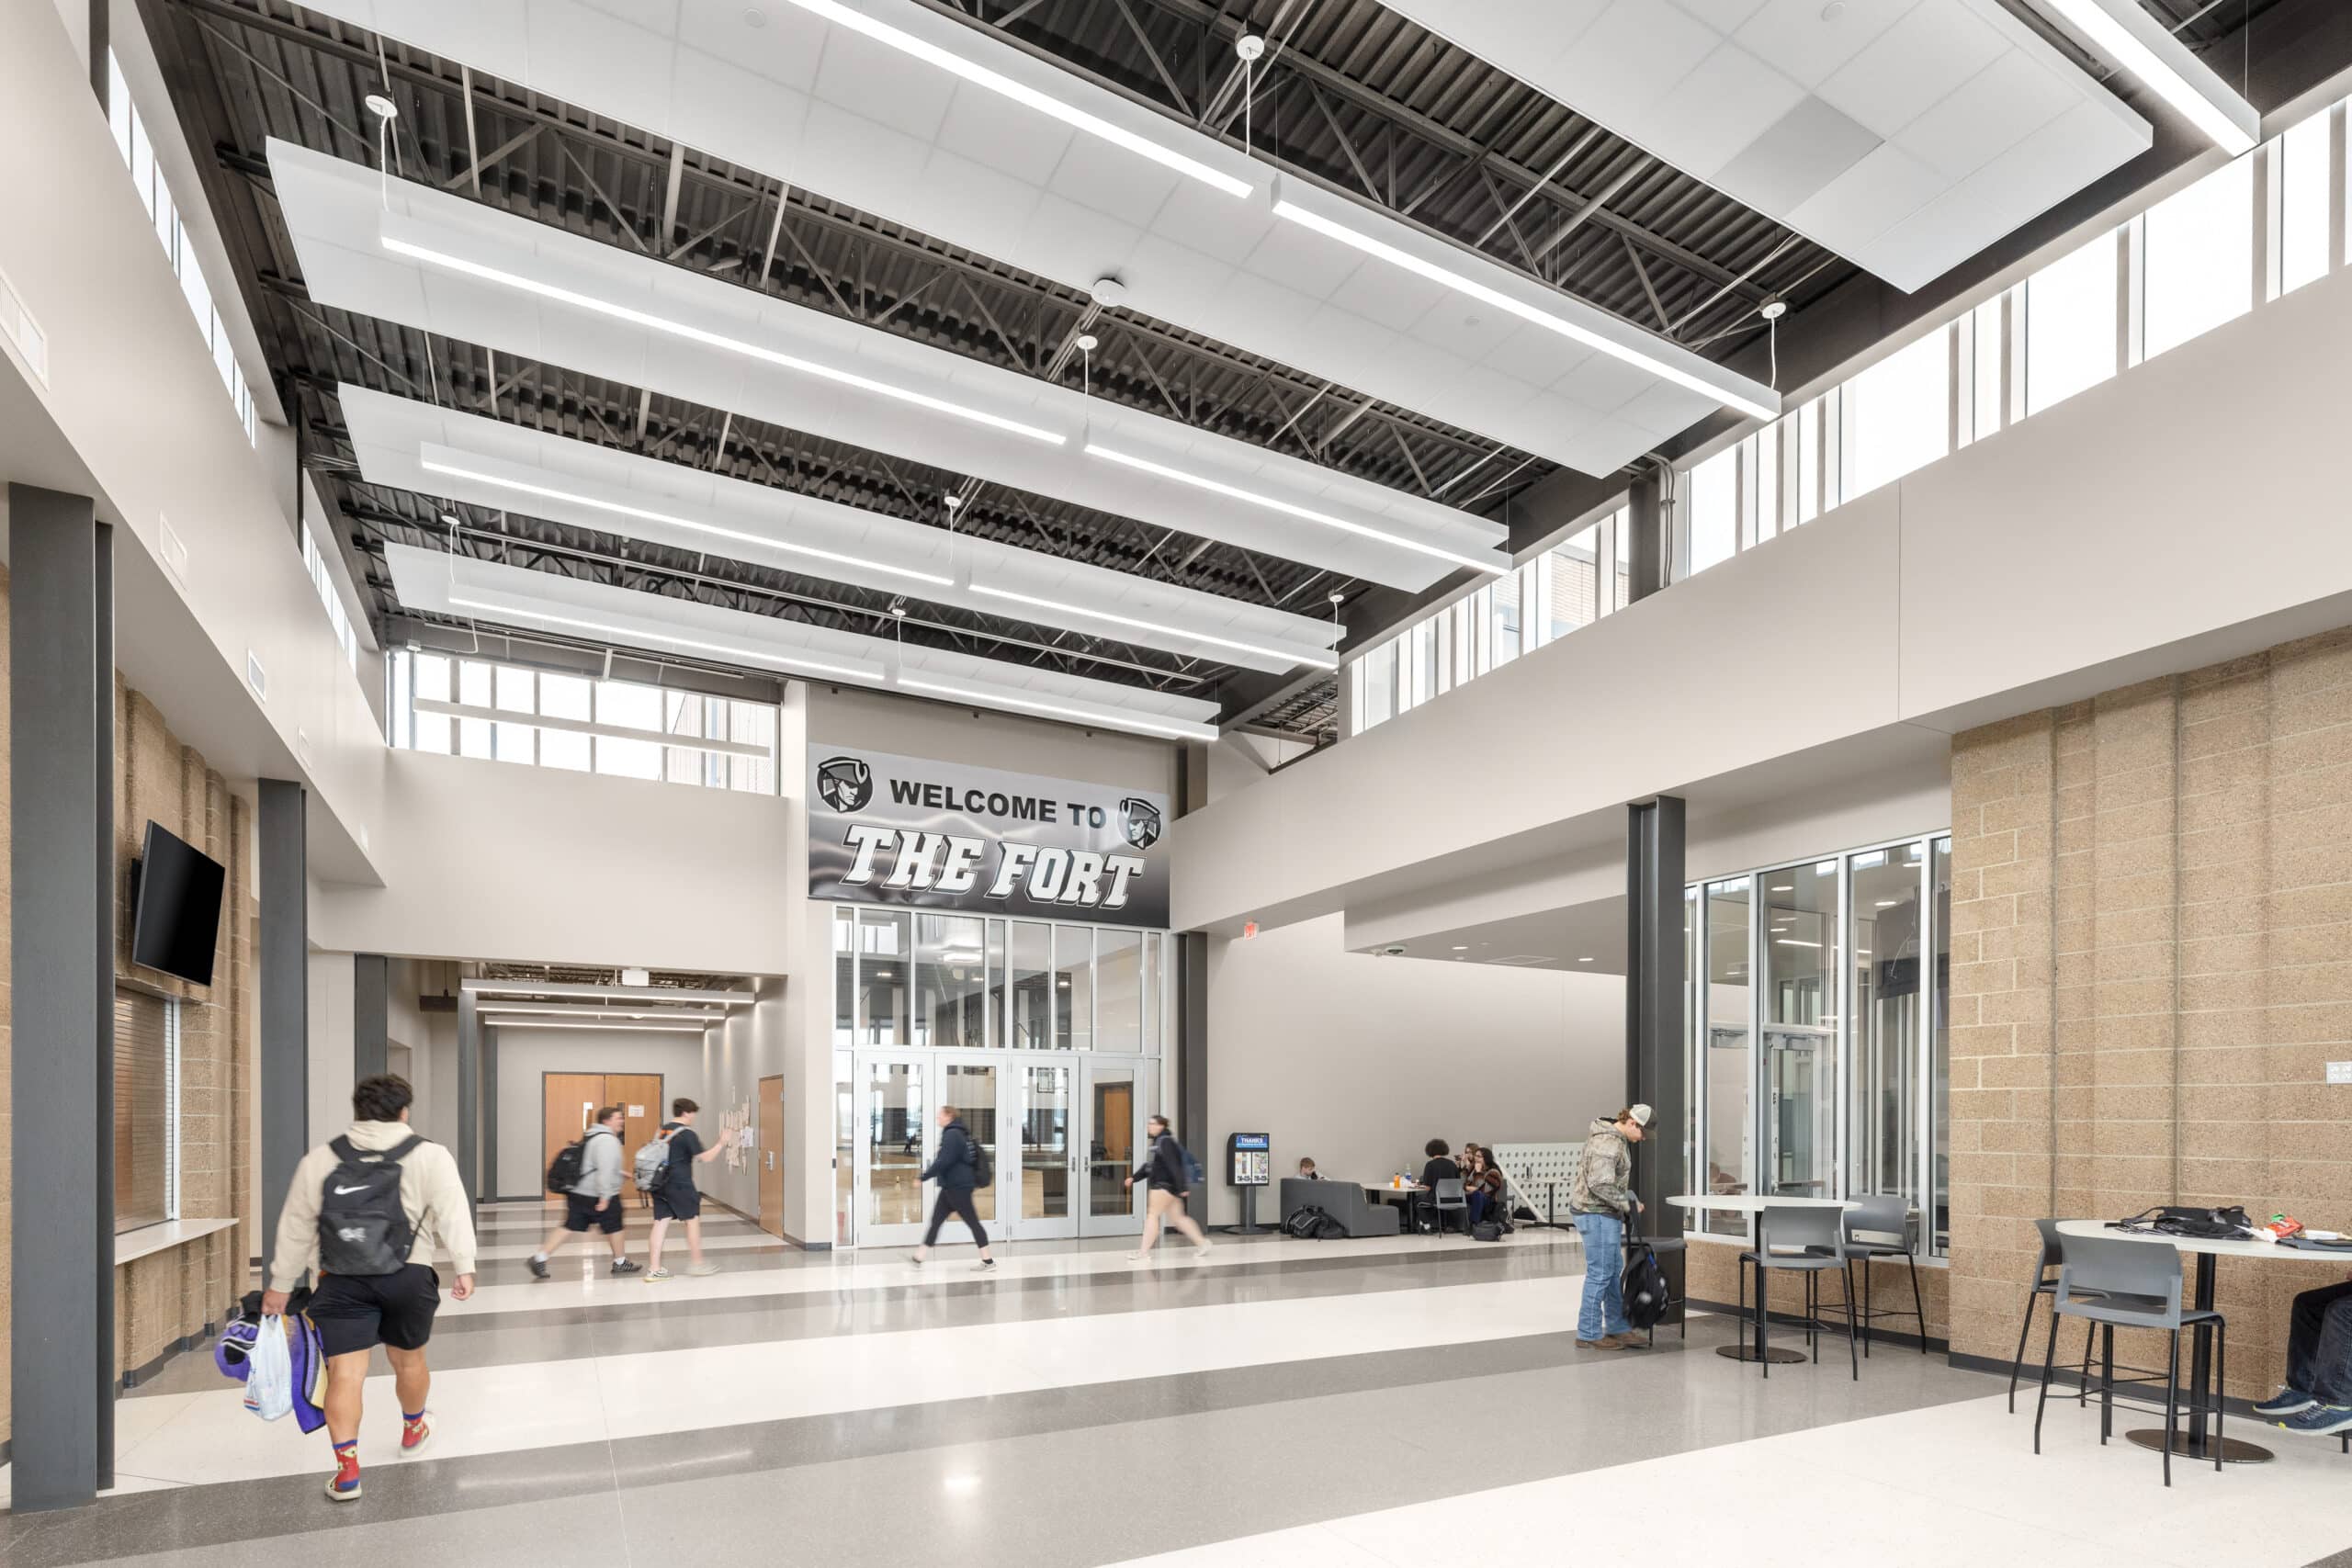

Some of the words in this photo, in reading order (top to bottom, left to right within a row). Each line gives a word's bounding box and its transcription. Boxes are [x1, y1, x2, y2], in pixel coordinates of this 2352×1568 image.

[889, 779, 1057, 823] WELCOME
[1067, 803, 1106, 829] TO
[839, 824, 986, 894] THE
[984, 840, 1147, 909] FORT
